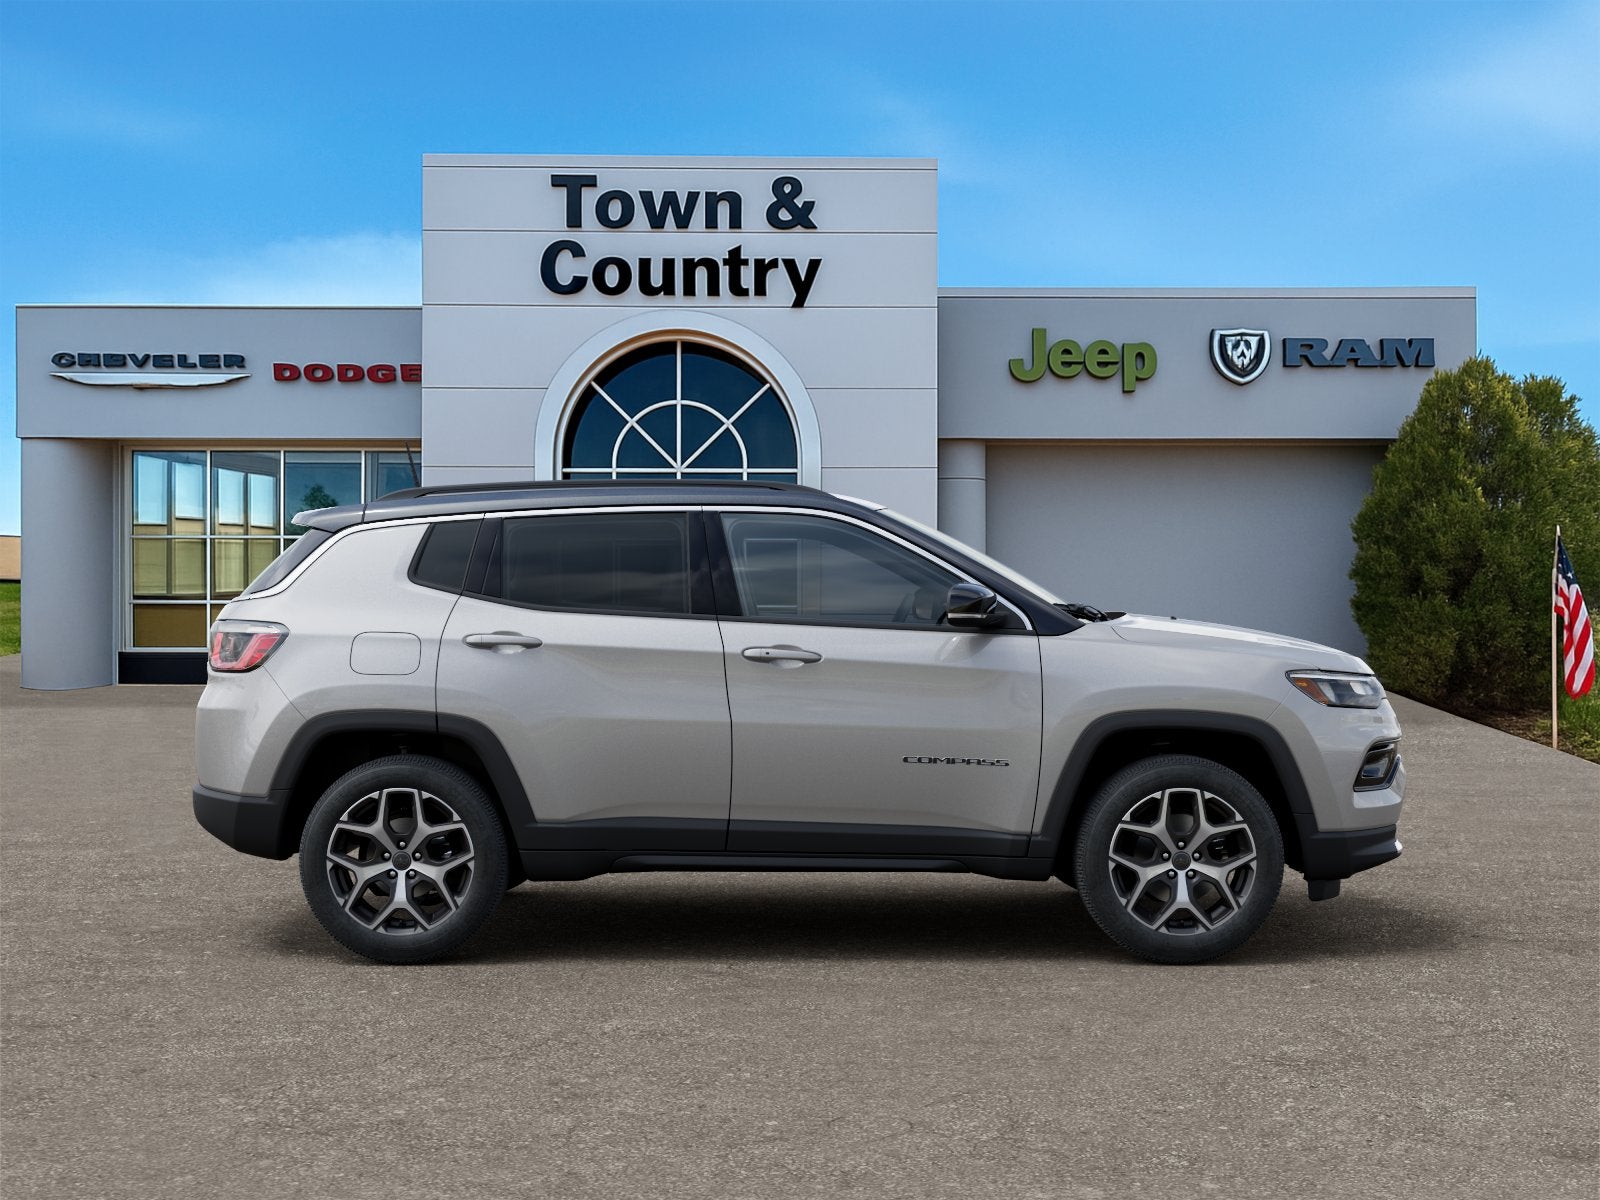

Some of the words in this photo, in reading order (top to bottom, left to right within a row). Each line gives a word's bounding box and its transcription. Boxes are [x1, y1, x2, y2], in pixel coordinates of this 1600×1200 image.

[551, 174, 743, 229] Town
[766, 176, 818, 230] &
[540, 239, 822, 308] Country
[273, 363, 422, 382] DODGE
[1009, 328, 1158, 393] Jeep
[1283, 338, 1436, 367] RAM
[902, 756, 1010, 767] COMPASS
